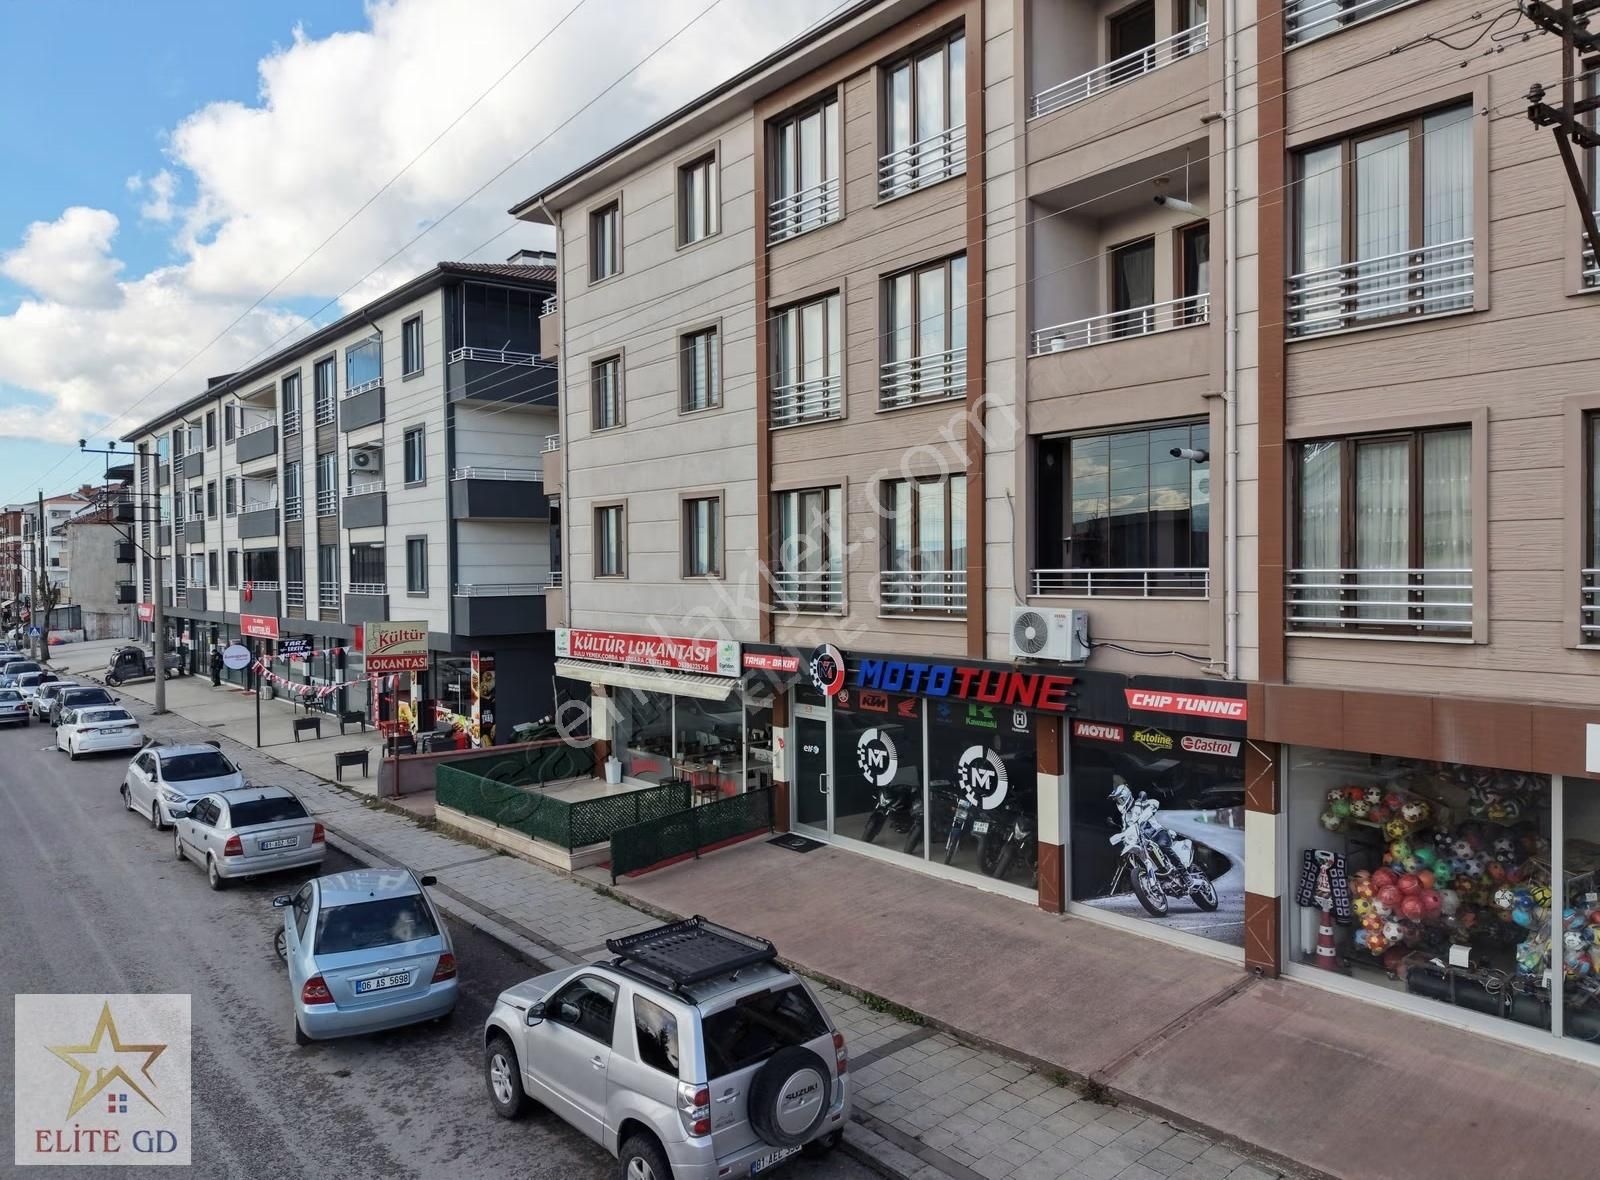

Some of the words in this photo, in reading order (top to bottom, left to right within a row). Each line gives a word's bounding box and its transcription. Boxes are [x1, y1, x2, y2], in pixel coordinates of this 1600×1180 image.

[379, 629, 426, 647] Kültür
[574, 633, 626, 654] KÜLTÜR
[628, 639, 711, 663] LOKANTASI
[367, 658, 427, 670] LOKANTASI
[744, 654, 766, 668] TAMİR
[772, 657, 797, 670] BAKIM
[862, 694, 887, 708] KTM
[1131, 693, 1173, 707] CHIP
[1176, 697, 1243, 715] TUNING
[965, 717, 998, 729] Kawasaki
[1077, 724, 1121, 740] MOTUL
[1134, 730, 1173, 747] Putoline
[1194, 738, 1233, 754] Castrol
[361, 981, 372, 991] 06
[375, 978, 386, 988] AS
[389, 974, 409, 986] 5698
[786, 1082, 818, 1100] SUZUKI
